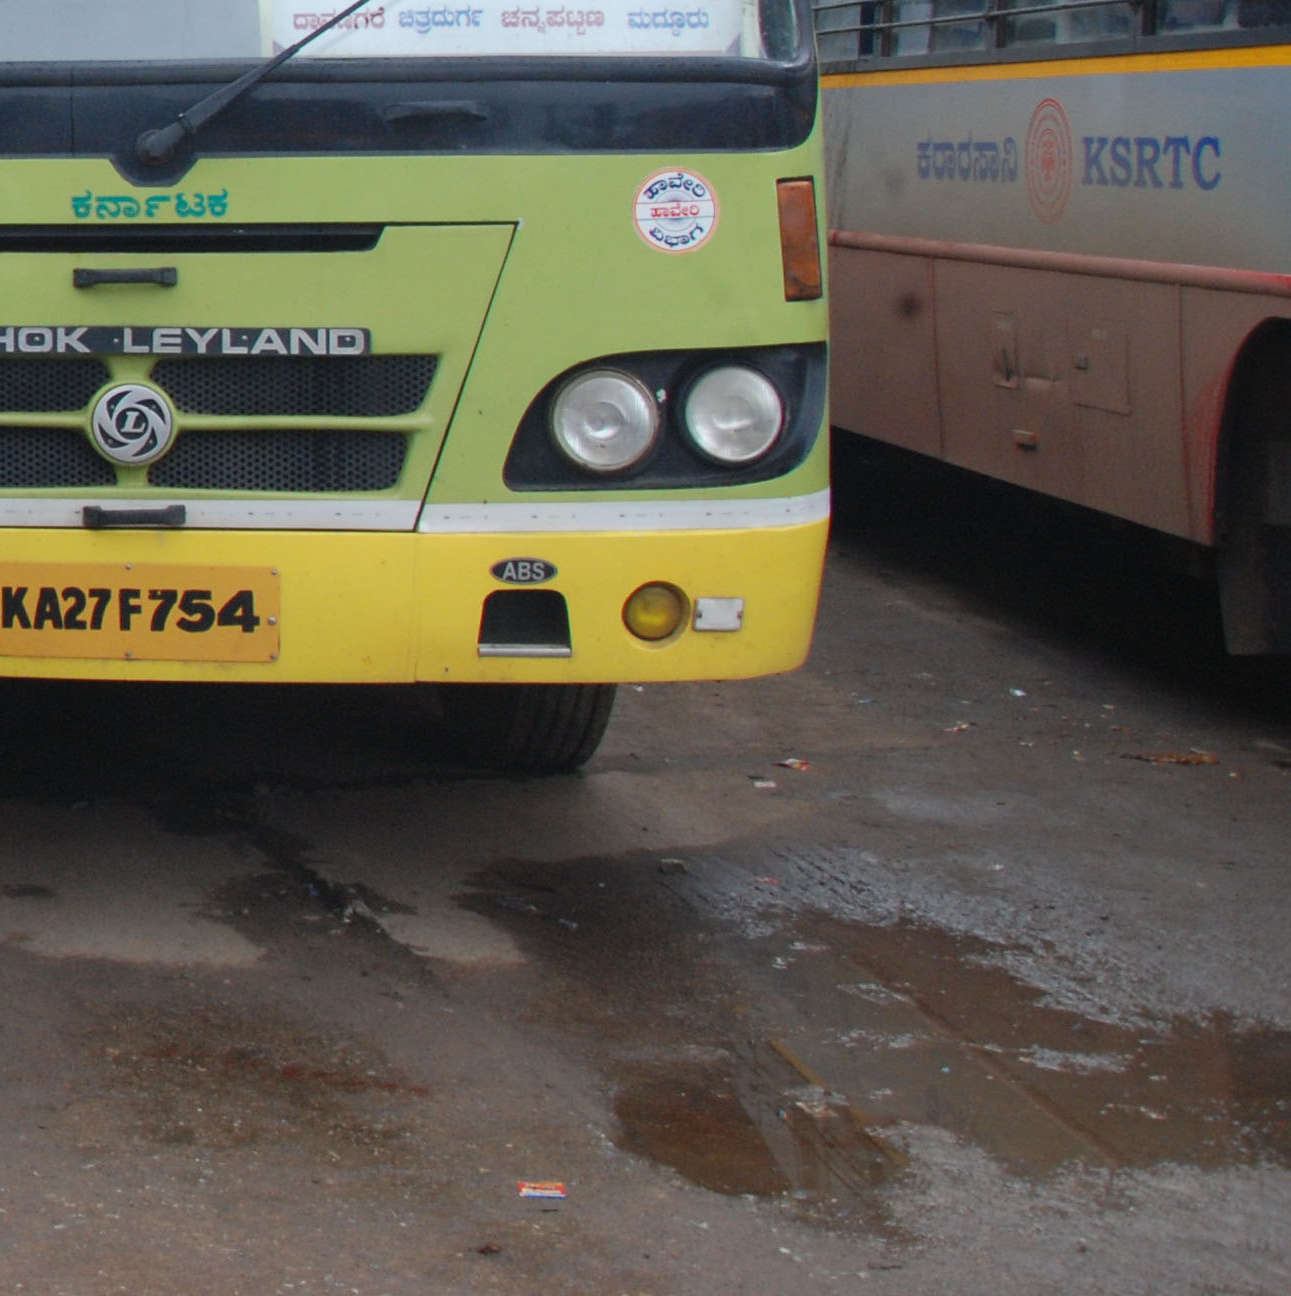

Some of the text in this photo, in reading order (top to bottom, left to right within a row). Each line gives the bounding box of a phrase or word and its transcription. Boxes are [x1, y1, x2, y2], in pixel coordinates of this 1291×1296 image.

[1081, 136, 1222, 191] KSRTC
[71, 189, 229, 219] ಕರ್ನಾಟಕ
[123, 327, 365, 355] LEYLAND
[120, 411, 146, 433] L
[502, 561, 545, 581] ABS
[1, 587, 260, 633] KA27F754
